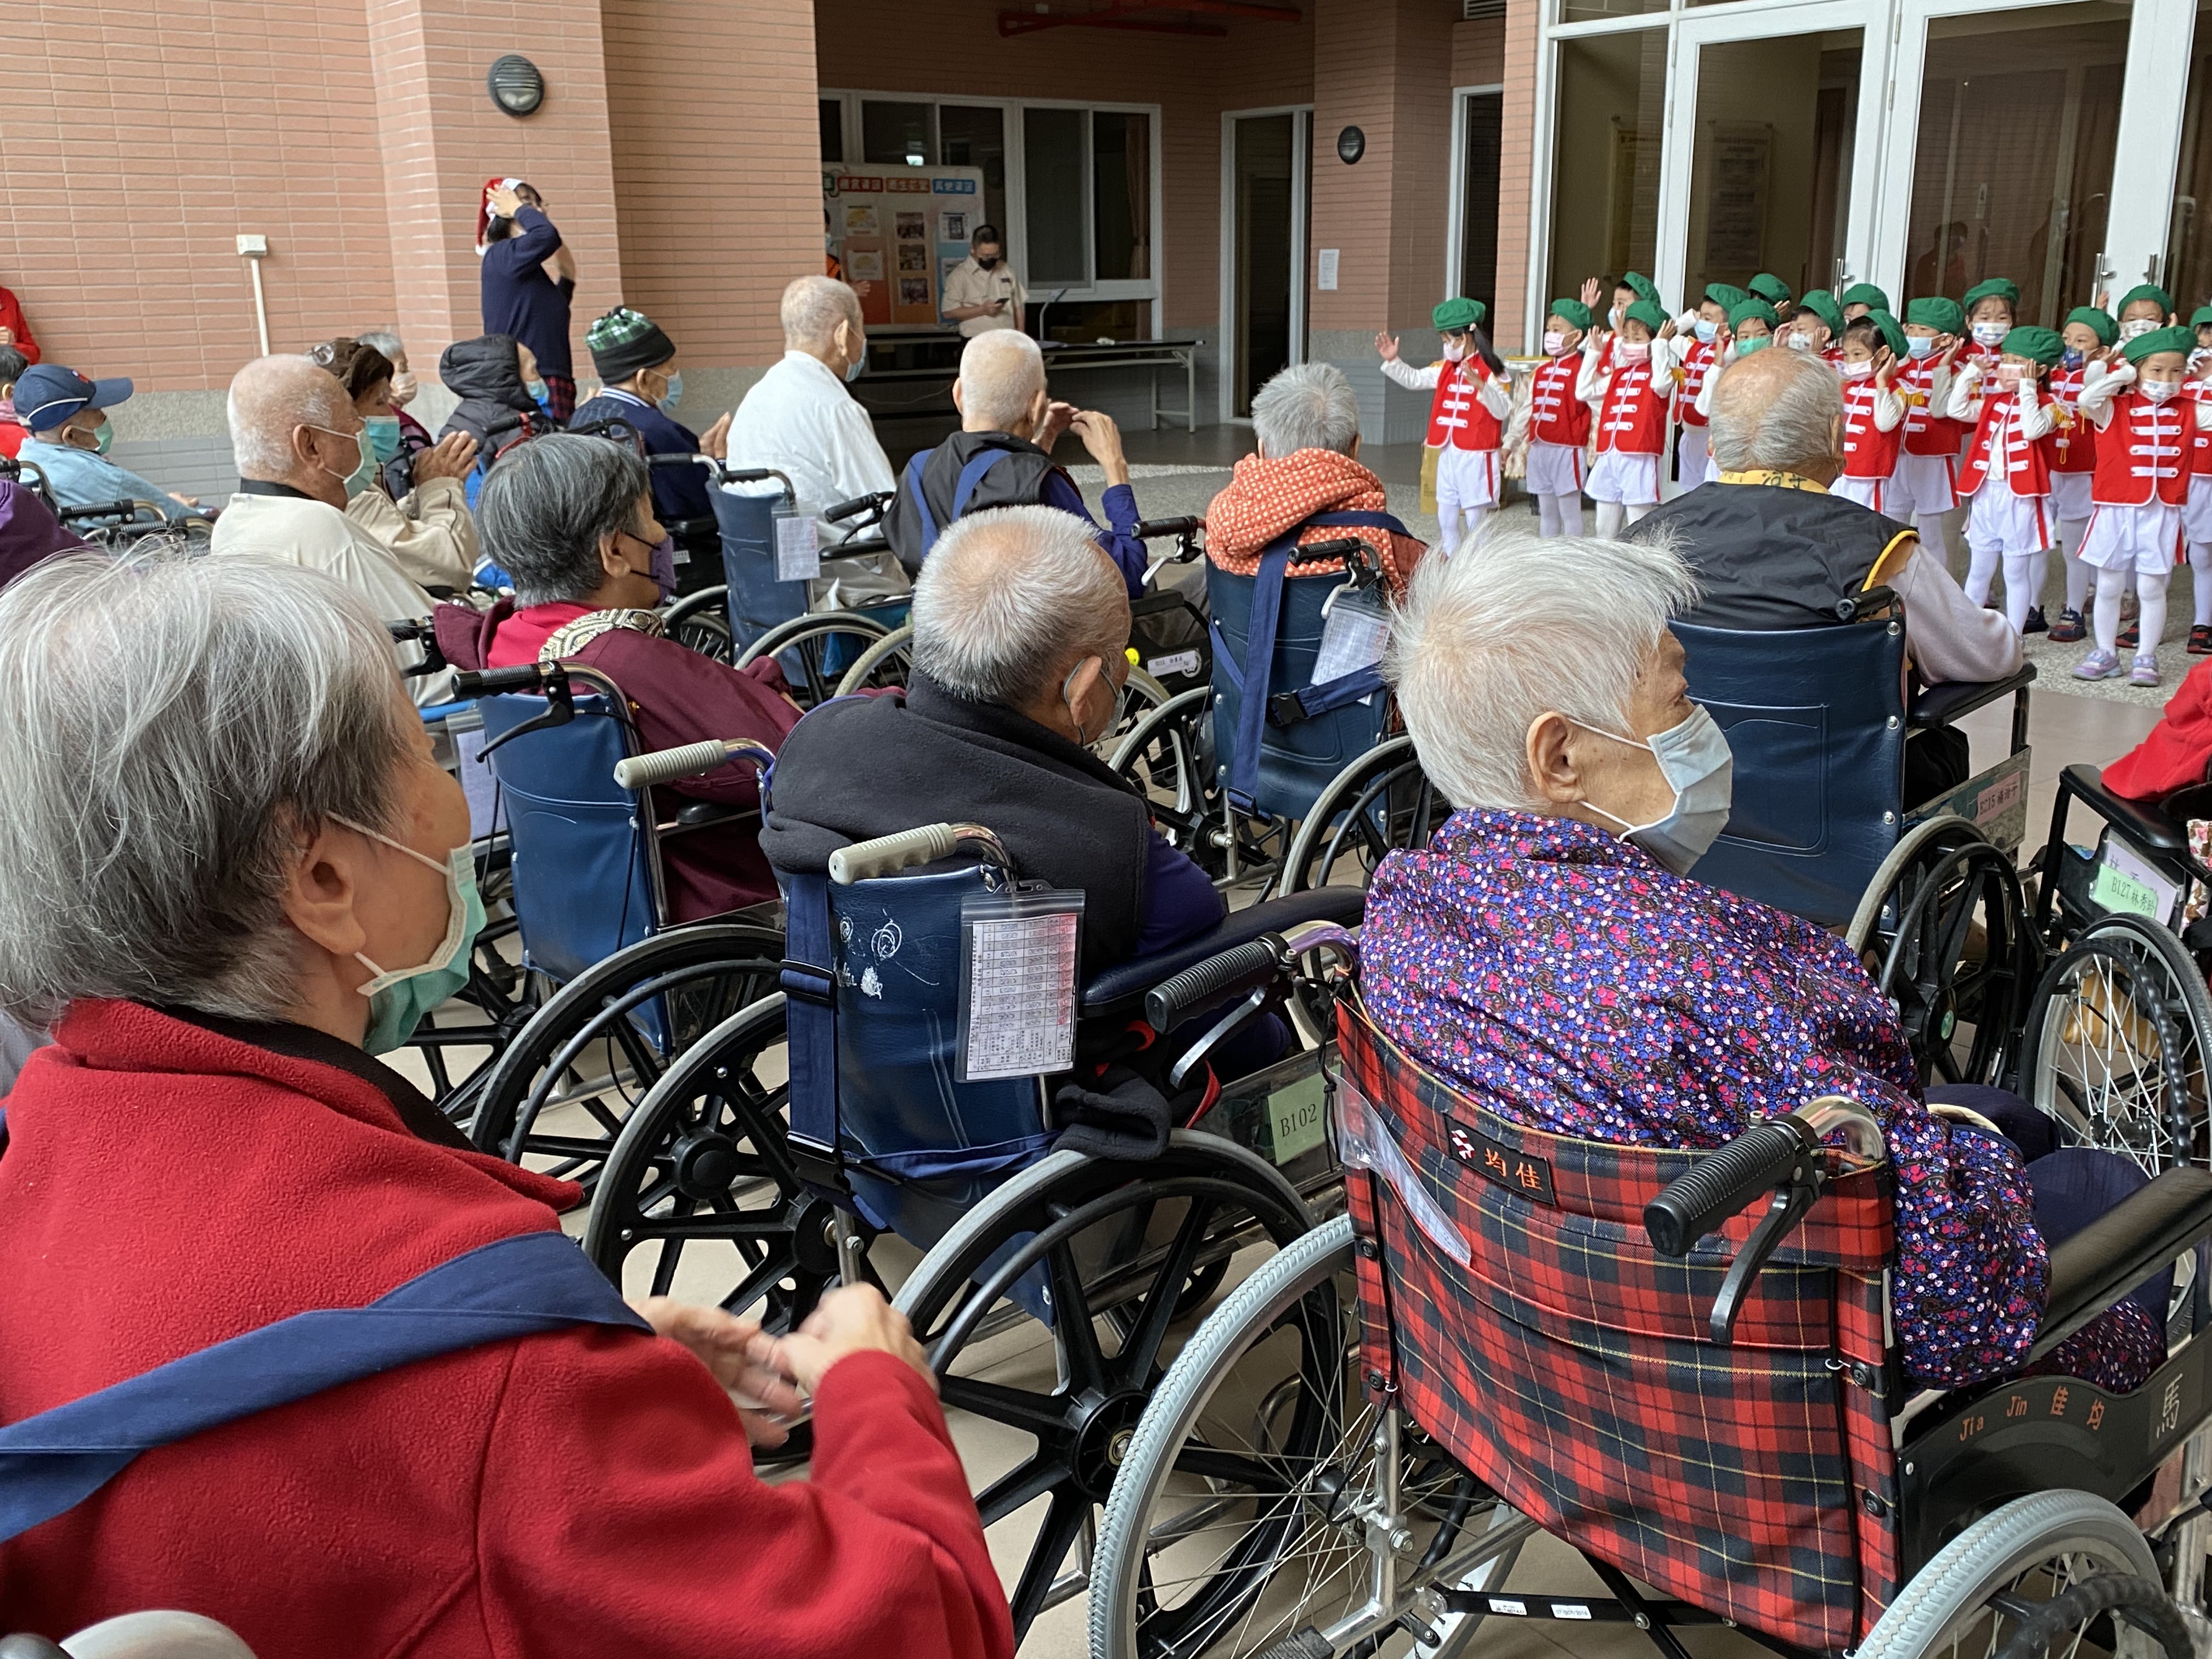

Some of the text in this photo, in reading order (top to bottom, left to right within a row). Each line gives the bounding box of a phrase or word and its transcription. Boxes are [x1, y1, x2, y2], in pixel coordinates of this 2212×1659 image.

[2111, 876, 2131, 899] B127
[1280, 1103, 1317, 1137] B102
[1485, 1148, 1544, 1191] 均佳
[2156, 1373, 2183, 1438] 馬
[1960, 1416, 1984, 1441] Jia
